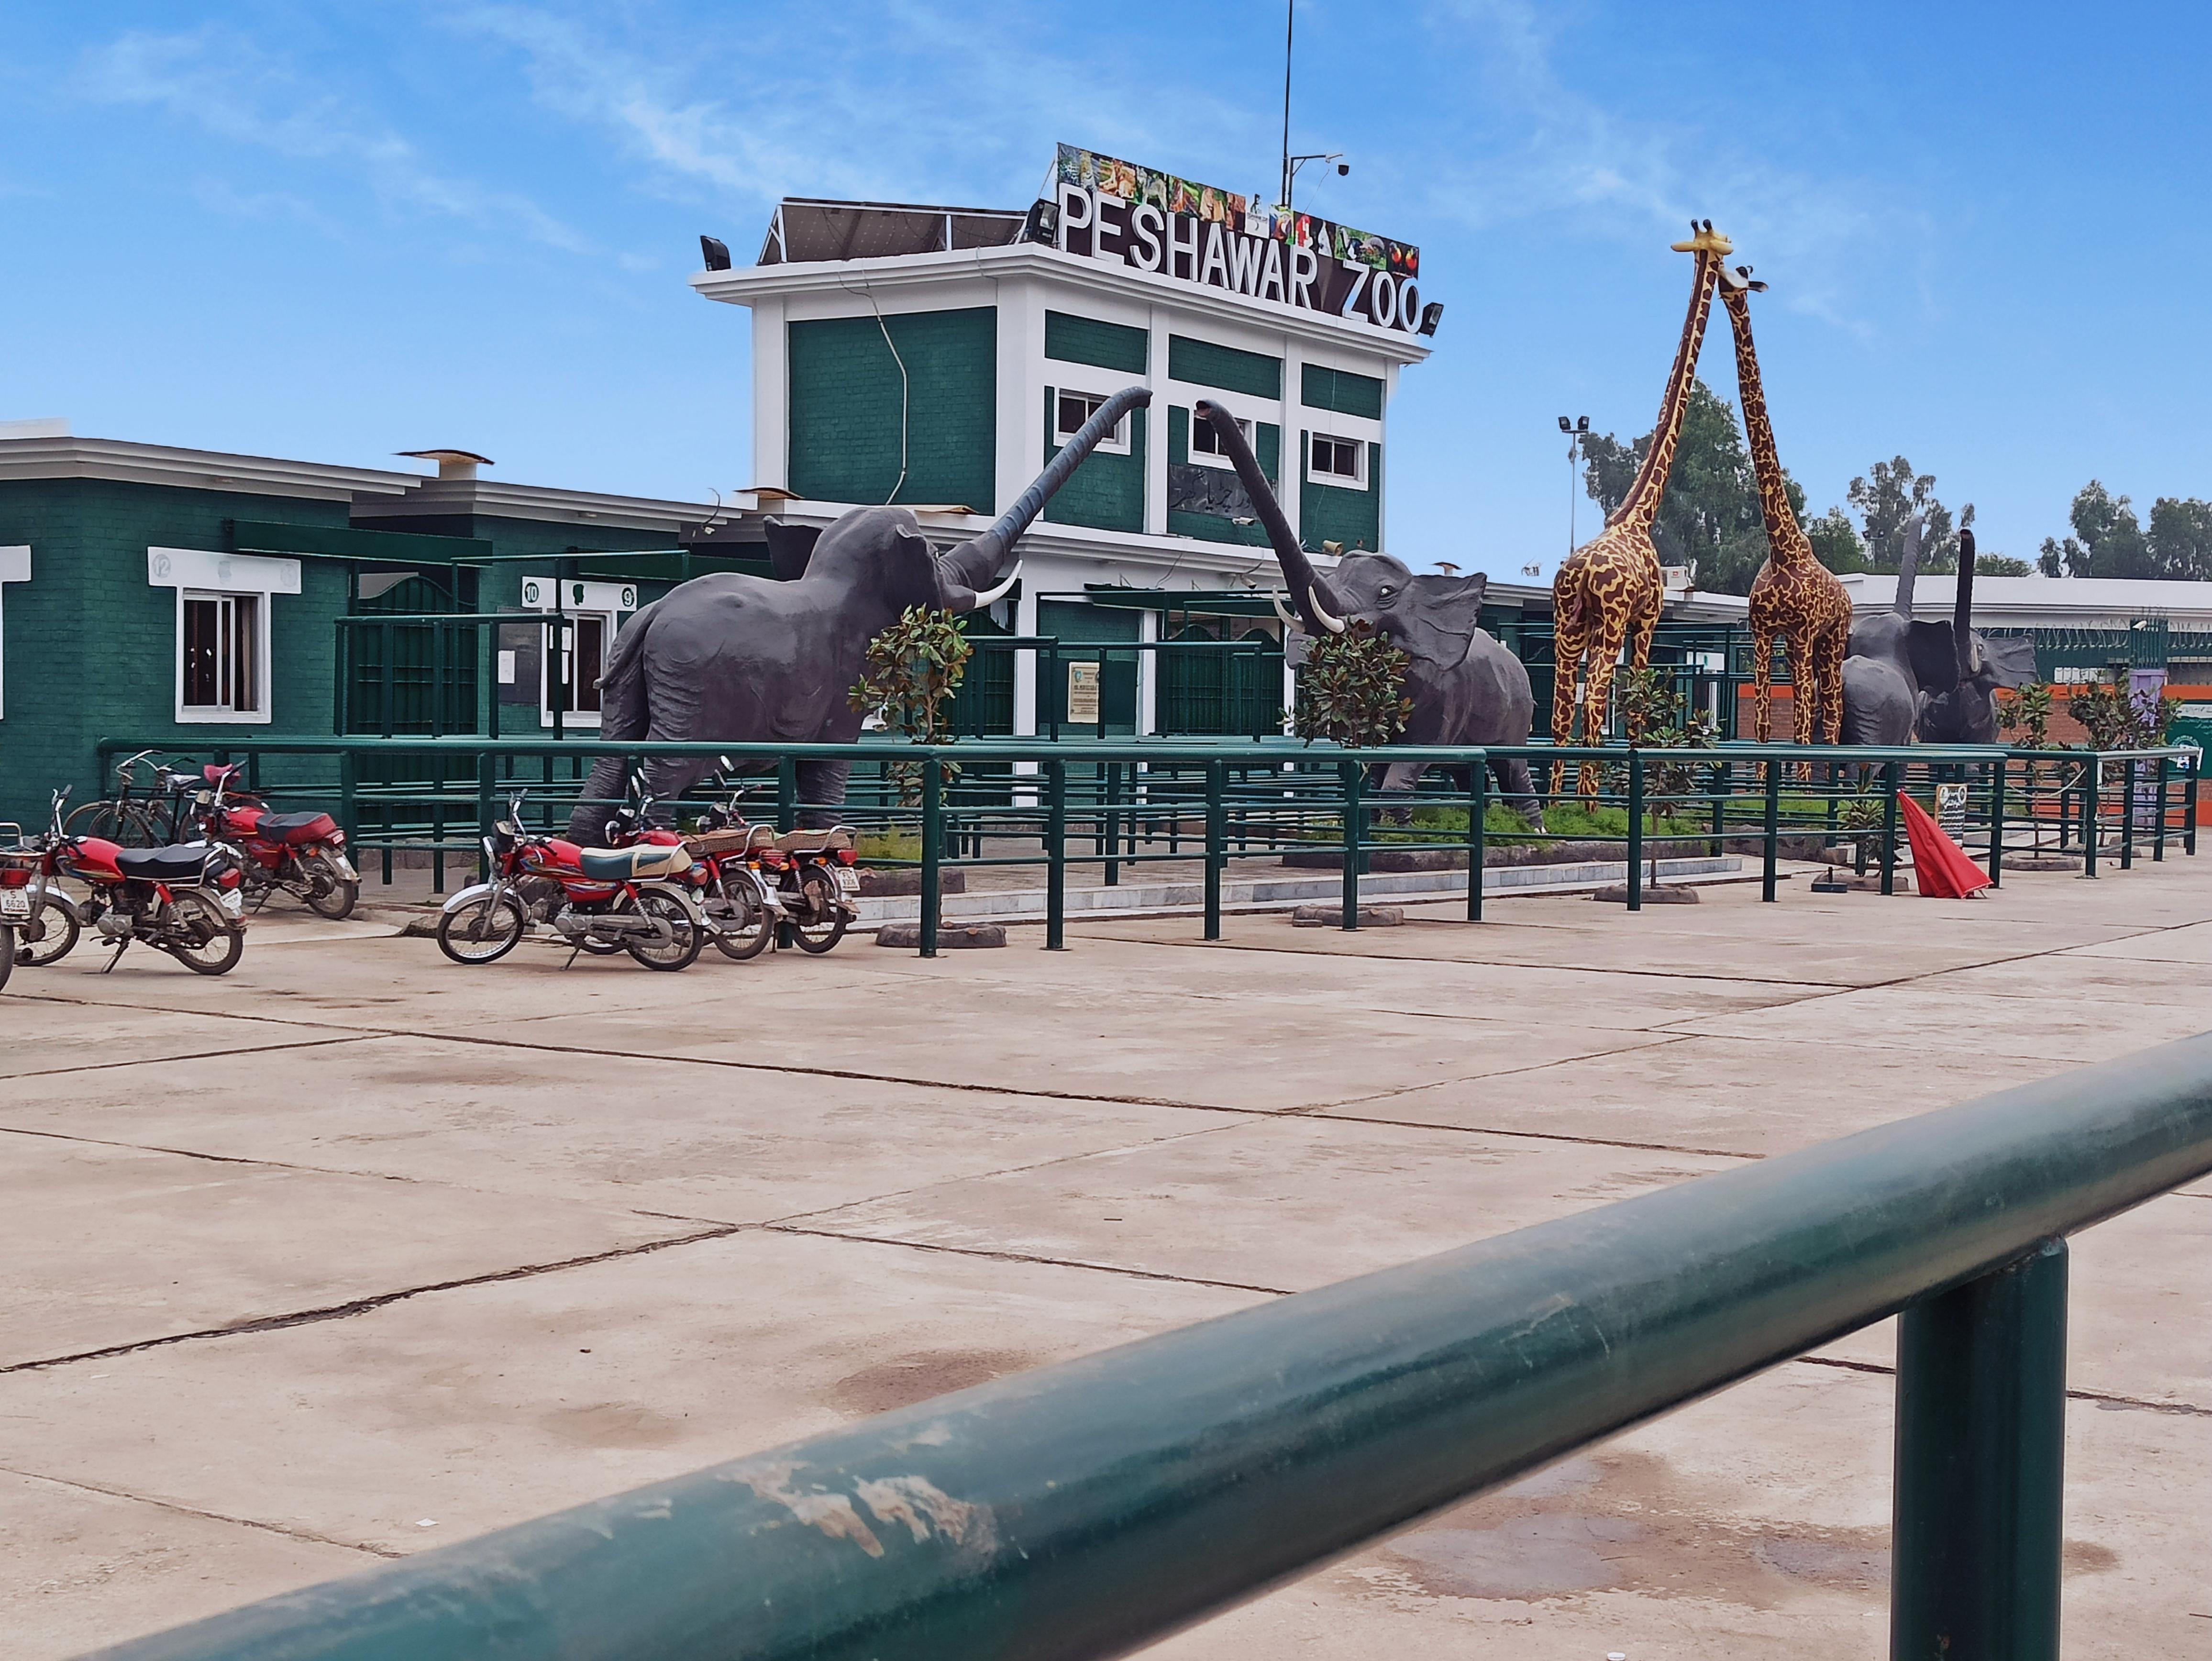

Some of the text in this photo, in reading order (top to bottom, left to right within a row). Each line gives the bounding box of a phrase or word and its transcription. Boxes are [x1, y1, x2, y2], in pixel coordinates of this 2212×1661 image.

[1059, 182, 1423, 333] PESHAWAR ZOO
[153, 557, 168, 578] 12
[526, 585, 537, 601] 10
[10, 890, 17, 899] S
